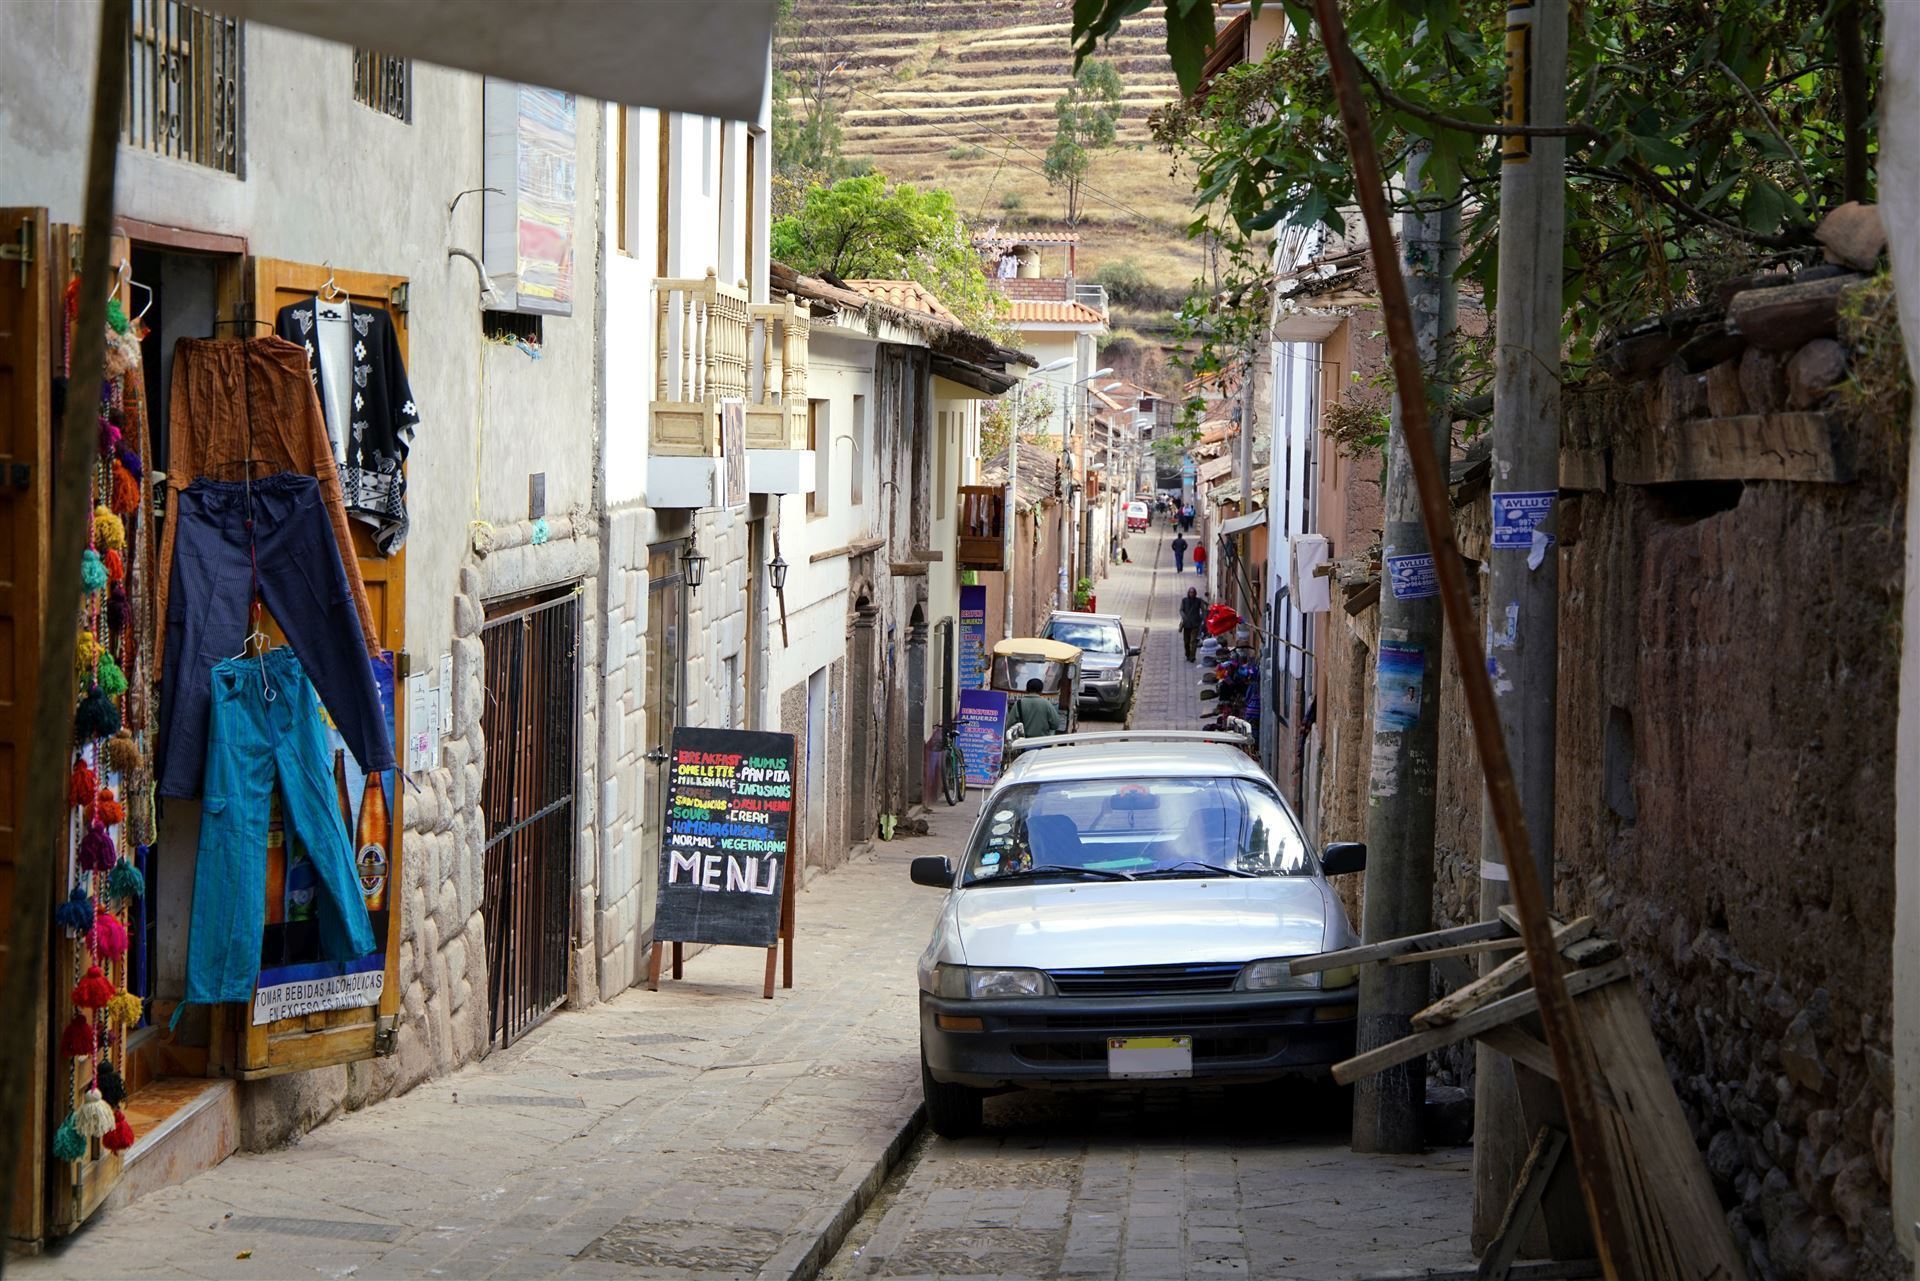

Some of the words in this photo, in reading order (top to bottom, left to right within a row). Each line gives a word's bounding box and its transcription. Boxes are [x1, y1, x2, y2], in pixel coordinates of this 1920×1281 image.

[1506, 499, 1538, 508] AYLLU
[1399, 559, 1425, 568] AYLLU
[678, 751, 741, 766] BREAKFAST
[749, 757, 787, 770] HUMUS
[678, 764, 735, 778] OMELETTE
[678, 776, 736, 789] MILKSHAKE
[737, 783, 791, 798] INFUSIONS
[731, 810, 769, 824] CREAM
[672, 834, 715, 849] NORMAL
[721, 838, 787, 853] VEGETARIANA
[669, 850, 777, 895] MENÚ
[256, 988, 282, 1008] TOMAR
[285, 981, 325, 1001] BEBIDAS
[326, 974, 383, 996] ALCOHÓLICAS
